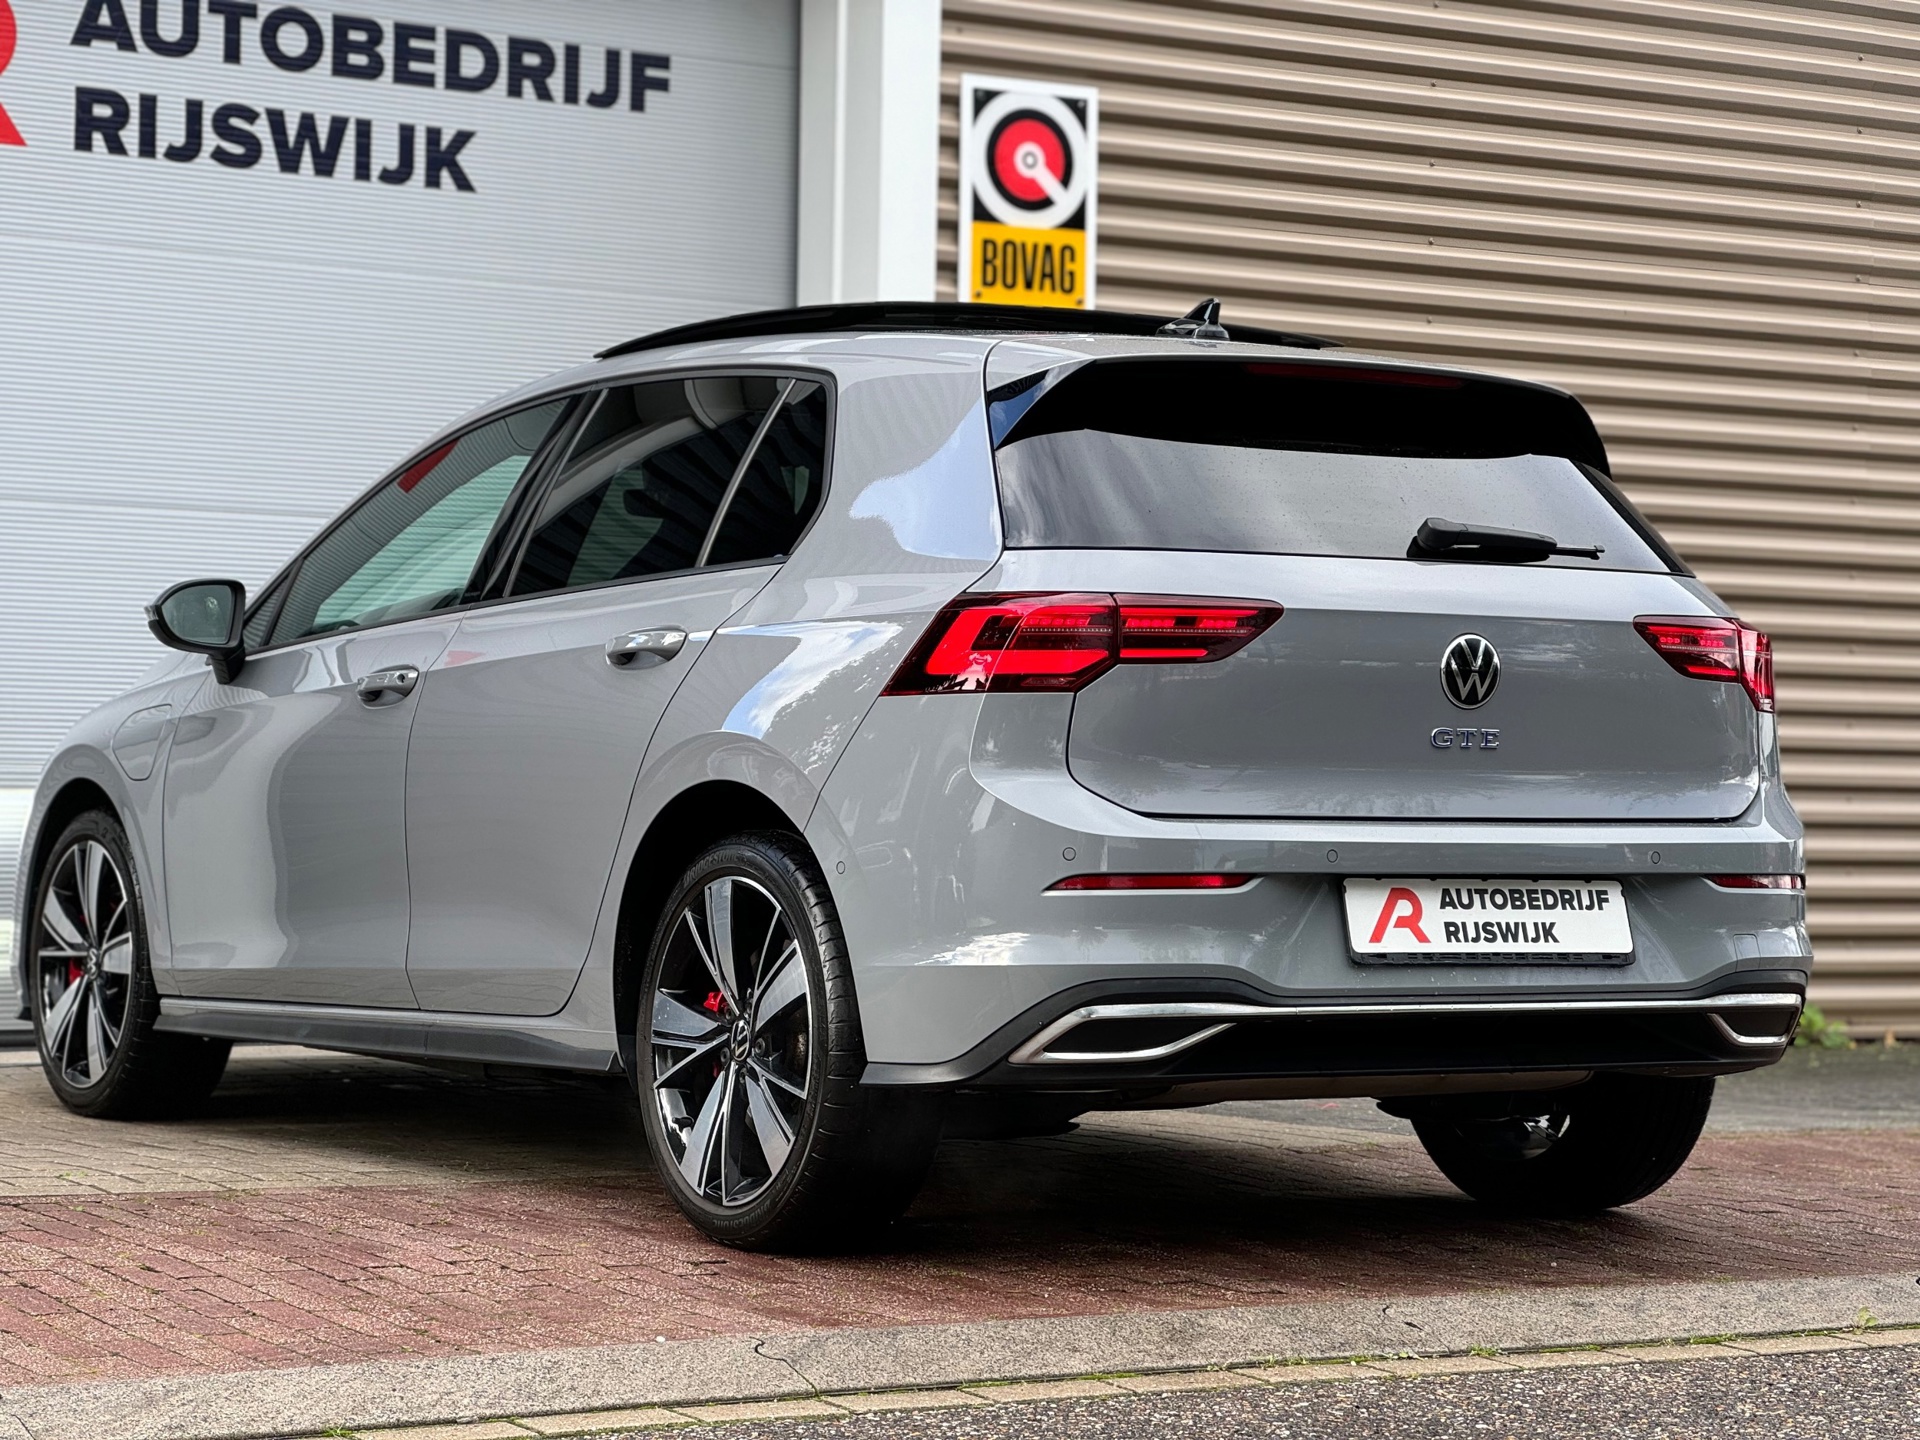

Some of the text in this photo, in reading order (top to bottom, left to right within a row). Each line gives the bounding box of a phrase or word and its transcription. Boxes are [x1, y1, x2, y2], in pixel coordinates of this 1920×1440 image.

[70, 0, 671, 113] AUTOBEDRIJF
[74, 86, 477, 193] RIJSWIJK
[981, 238, 1075, 294] BOVAG
[1431, 727, 1500, 749] GTE
[1440, 888, 1609, 911] AUTOBEDRIJF
[1444, 921, 1560, 943] RIJSWIJK
